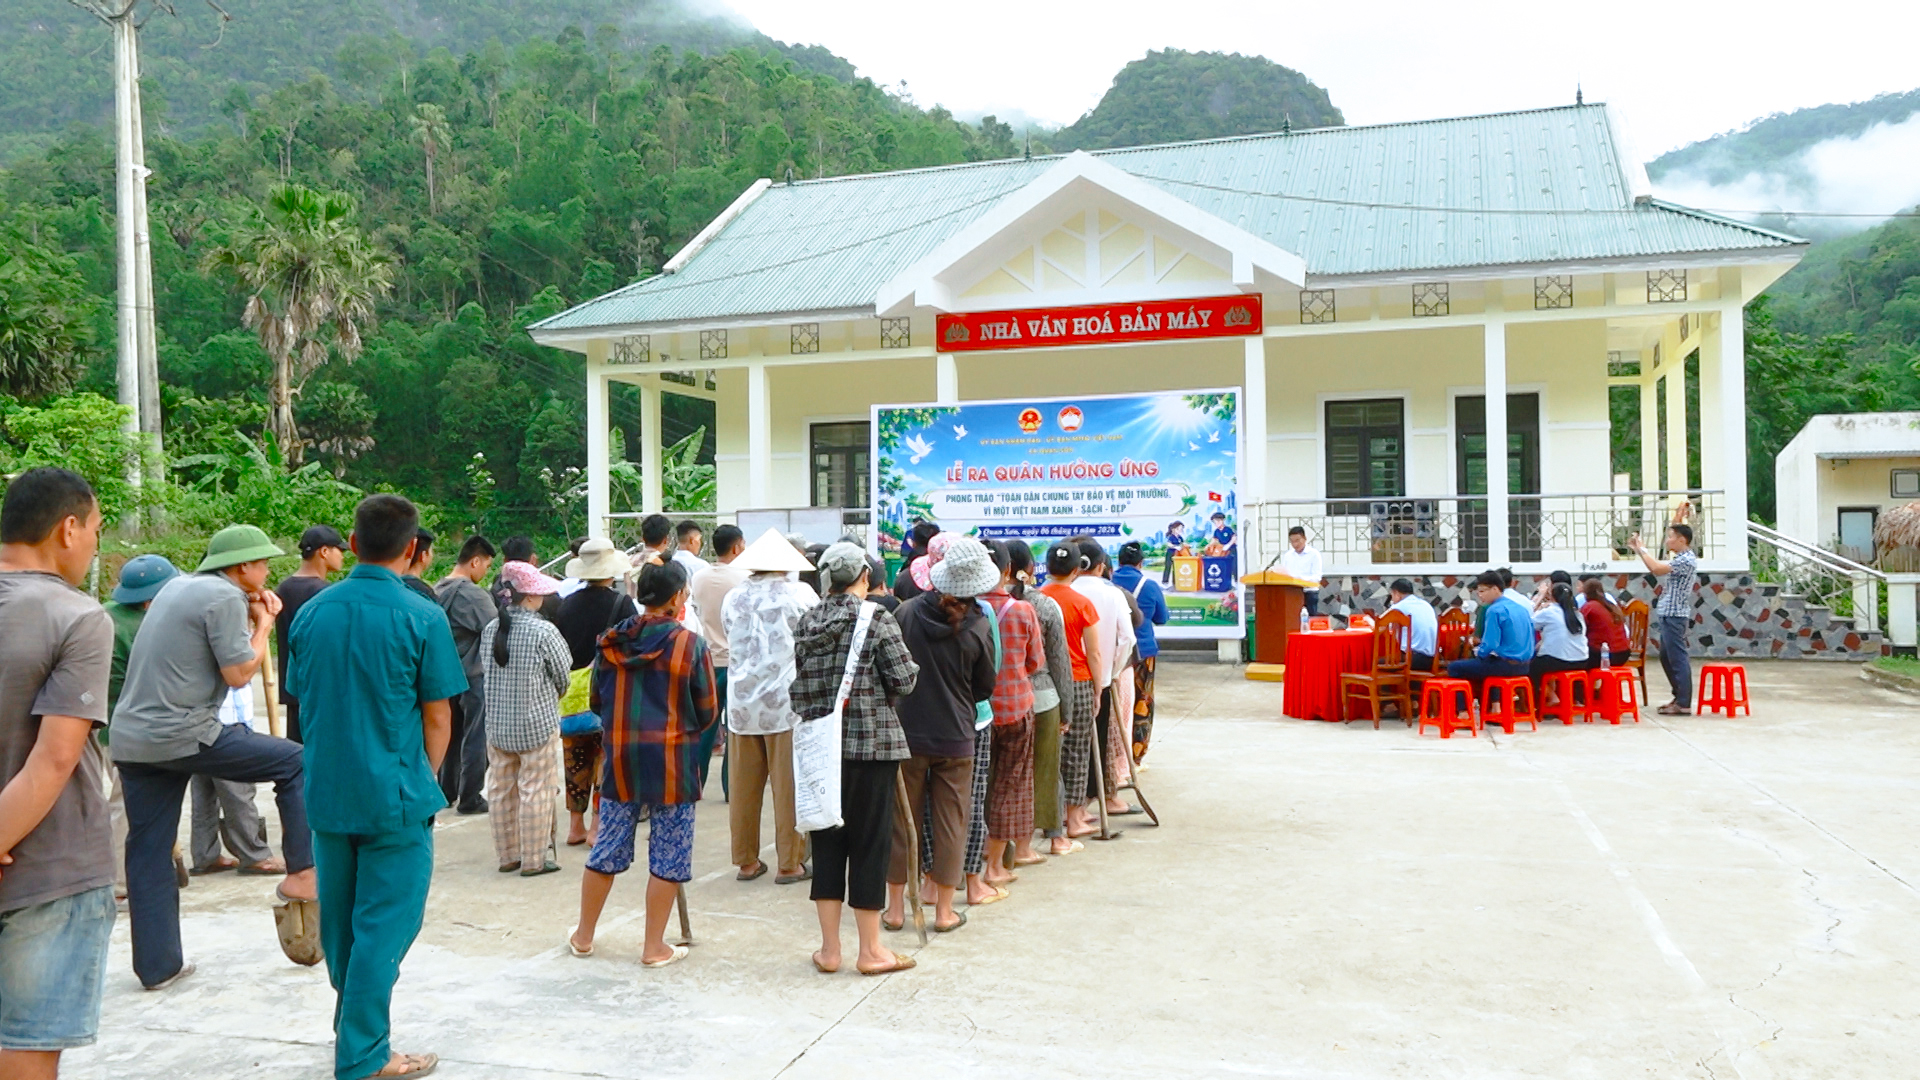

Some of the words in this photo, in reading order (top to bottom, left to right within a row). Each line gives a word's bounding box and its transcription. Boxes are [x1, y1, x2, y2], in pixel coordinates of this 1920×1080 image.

[979, 316, 1022, 341] NHÀ
[1027, 314, 1067, 337] VĂN
[1072, 310, 1115, 335] HOÁ
[1119, 305, 1162, 333] BẢN
[1166, 305, 1213, 330] MÁY
[946, 459, 963, 482] LỄ
[967, 466, 989, 482] RA
[994, 460, 1044, 482] QUÂN
[1119, 457, 1159, 478] ỨNG
[945, 493, 972, 503] PHONG
[1042, 491, 1069, 502] CHUNG
[1072, 491, 1084, 502] TAY
[1117, 488, 1133, 500] MÔI
[993, 504, 1010, 517] MỘT
[1012, 504, 1028, 518] VIỆT
[1031, 506, 1049, 515] NAM
[1051, 505, 1073, 515] XANH
